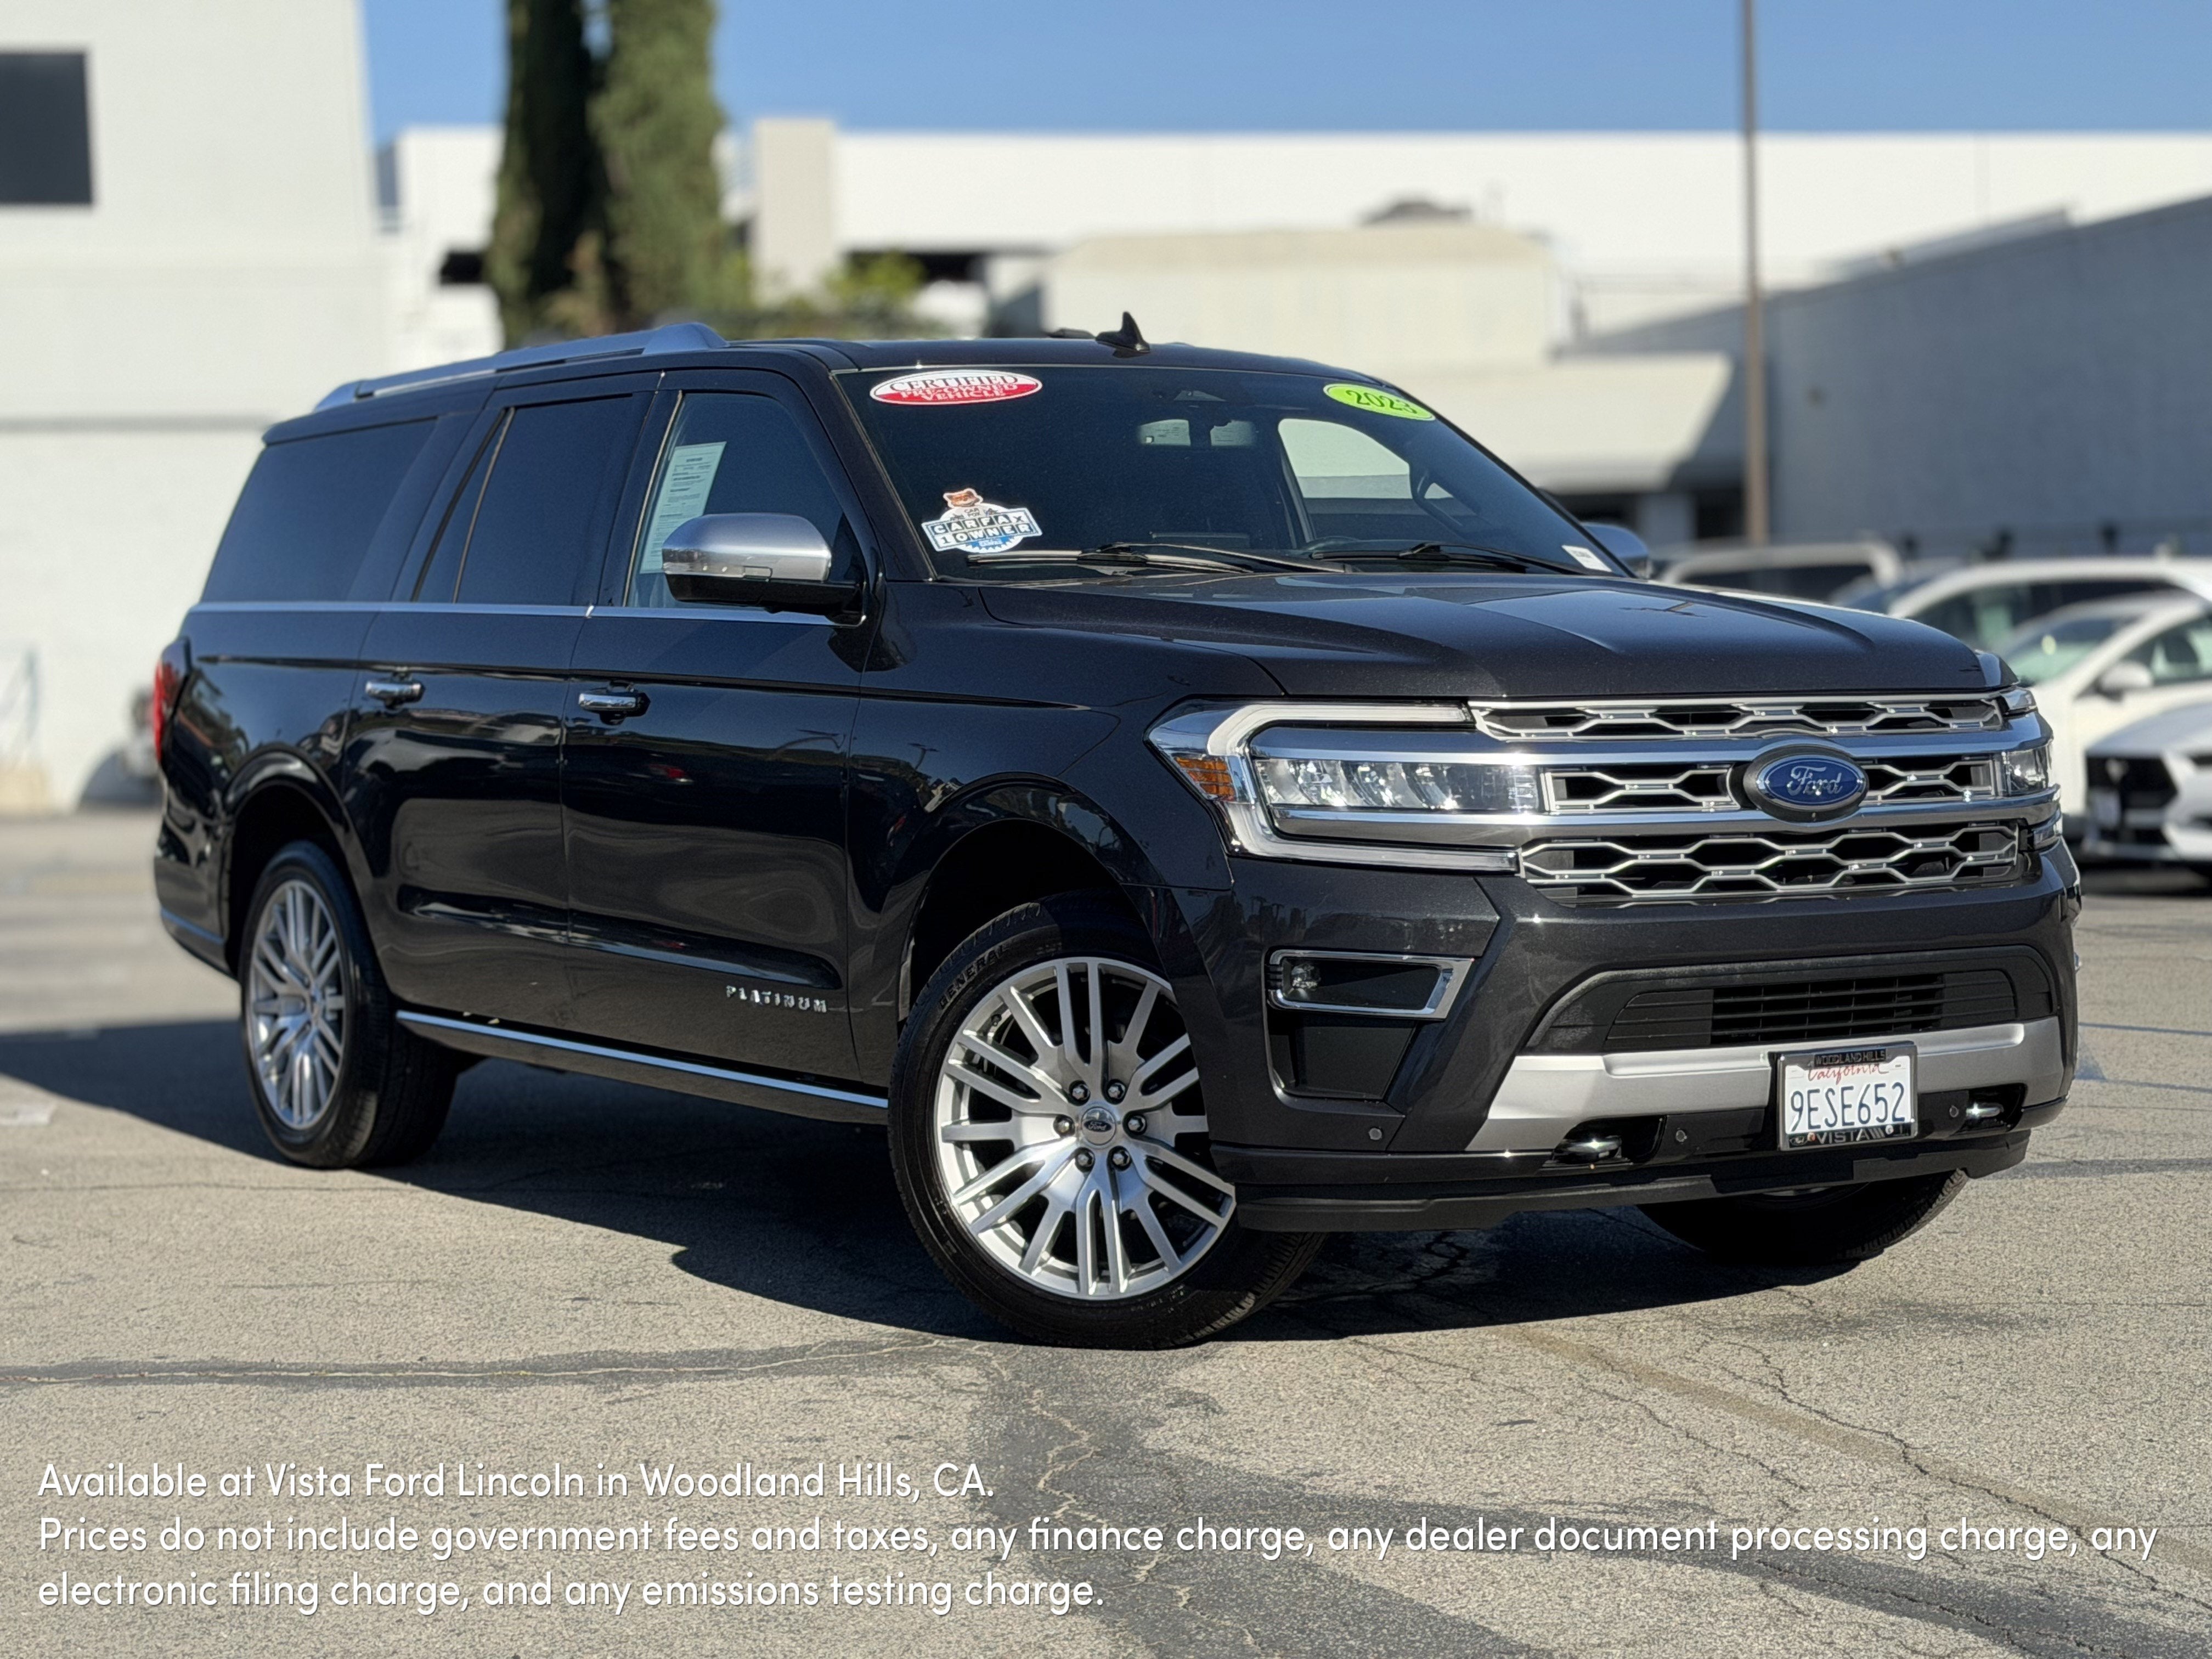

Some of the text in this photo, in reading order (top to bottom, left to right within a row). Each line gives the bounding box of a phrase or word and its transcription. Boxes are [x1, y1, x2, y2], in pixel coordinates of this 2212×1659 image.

[890, 375, 1018, 391] CERTIFIED
[900, 384, 1018, 398] PRE-OWNED
[921, 390, 1005, 401] VEHICLE
[1346, 390, 1418, 414] 2023
[933, 515, 1025, 534] CARFAX
[955, 524, 1032, 543] OWNER
[1787, 765, 1843, 795] Ford
[939, 944, 1009, 1009] GENERAL
[726, 985, 827, 1013] PLATINUM
[1816, 1049, 1885, 1065] WOODLAND HILLS
[1808, 1063, 1889, 1085] California
[1791, 1082, 1905, 1132] 9ESE652
[1816, 1128, 1870, 1144] VISTA
